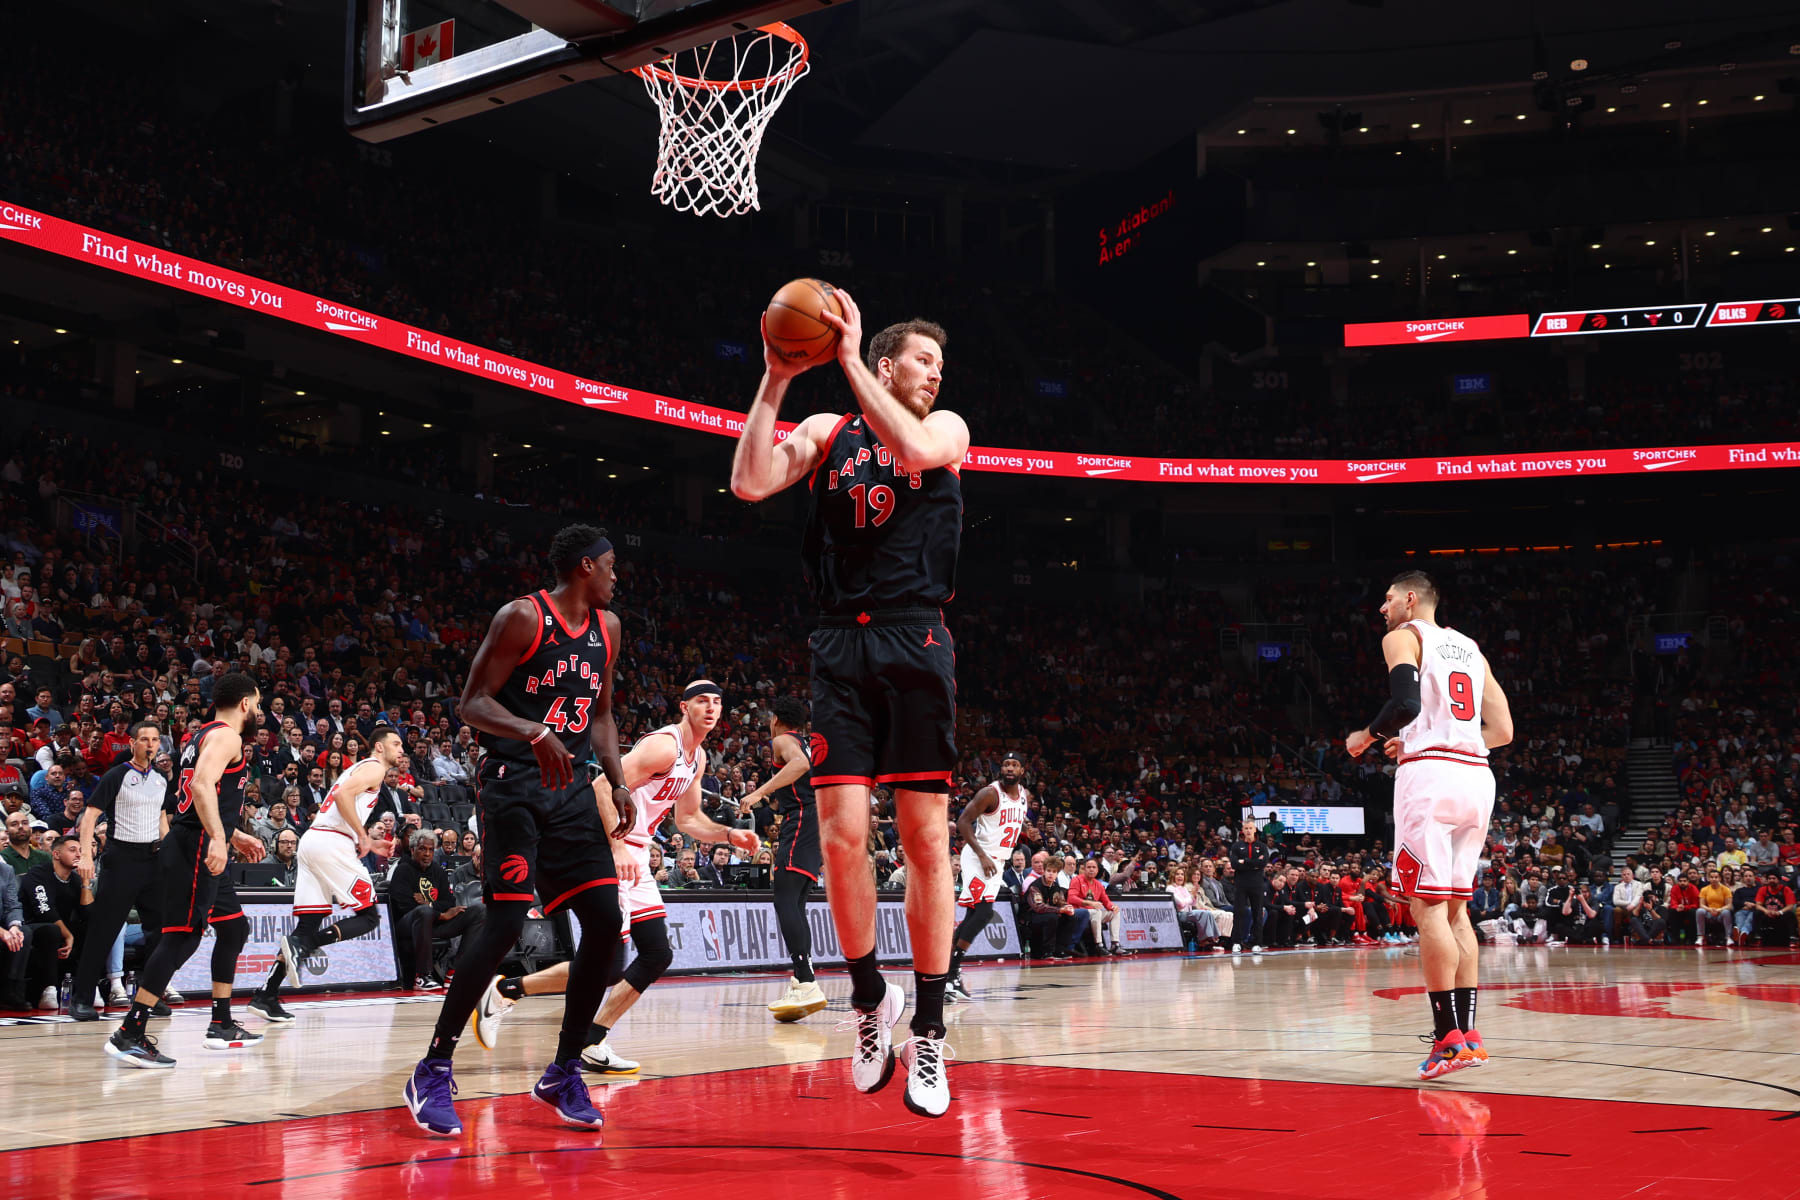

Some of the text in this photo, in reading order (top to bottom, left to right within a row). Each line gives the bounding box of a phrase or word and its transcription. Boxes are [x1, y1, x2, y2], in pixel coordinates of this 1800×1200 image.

[1098, 189, 1177, 247] Sotiaban
[1098, 232, 1142, 267] Aen
[82, 233, 283, 310] Find what moves you
[316, 301, 378, 330] SPORTCHEK
[1546, 311, 1683, 330] REB 1 0
[1718, 308, 1747, 320] BLKS
[1406, 321, 1465, 332] SPORTCHEK
[406, 331, 555, 390] Find what moves you
[575, 379, 629, 401] SPORTCHEK
[1459, 378, 1485, 390] IBM
[655, 400, 685, 420] Find
[689, 410, 722, 428] what
[219, 453, 245, 470] 120
[977, 454, 1023, 467] moves
[1026, 458, 1054, 472] you
[1077, 456, 1132, 469] SPORTCHEK
[1633, 450, 1697, 461] SPORTCHEK
[1728, 449, 1767, 463] Find
[1159, 462, 1319, 481] Find what moves you
[1347, 461, 1407, 472] SPORTCHEK
[1436, 457, 1608, 475] Find what moves you
[847, 483, 896, 529] 19
[624, 534, 641, 547] 121
[545, 616, 553, 626] 6
[1449, 671, 1475, 721] 9
[543, 697, 593, 733] 43
[1278, 808, 1330, 832] IBM
[1000, 826, 1019, 848] 21
[235, 955, 276, 973] ESP
